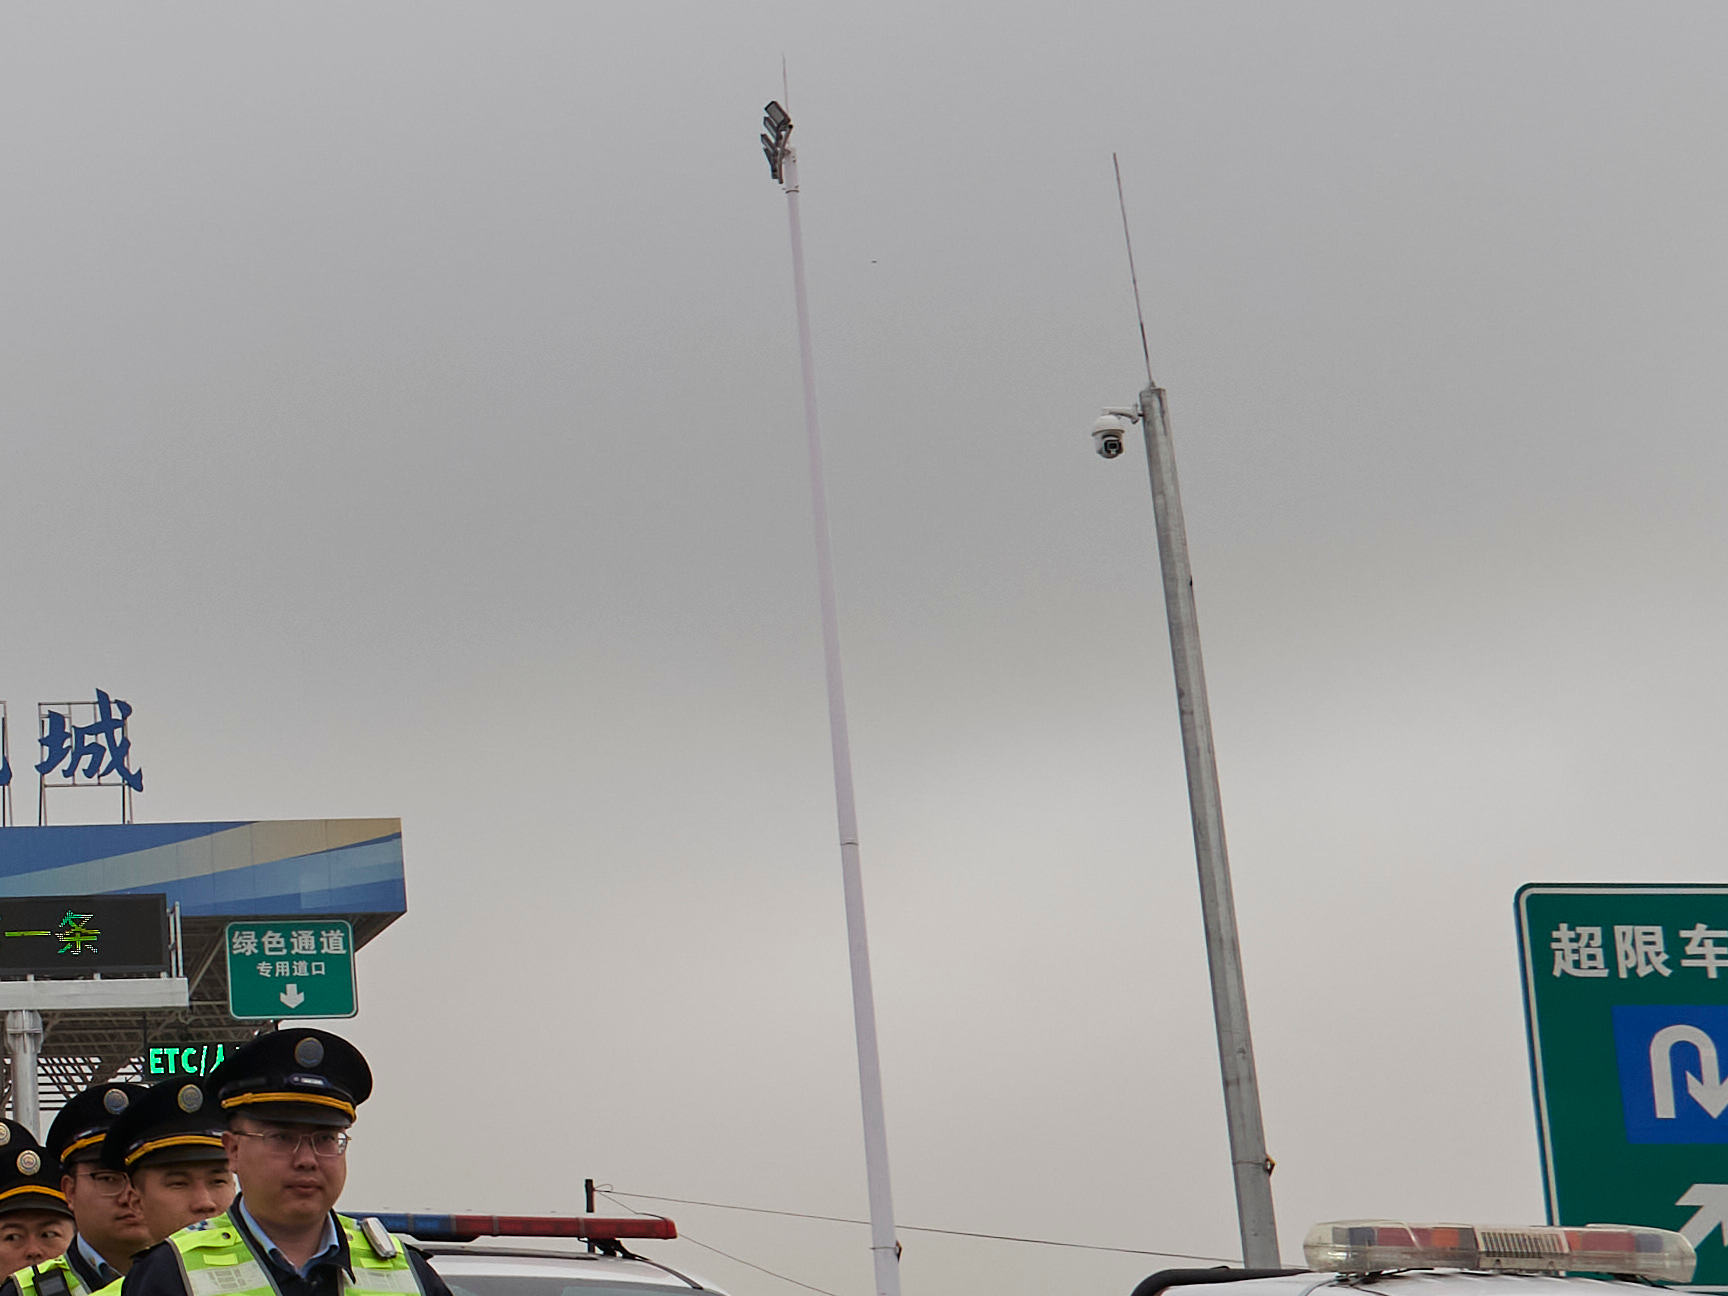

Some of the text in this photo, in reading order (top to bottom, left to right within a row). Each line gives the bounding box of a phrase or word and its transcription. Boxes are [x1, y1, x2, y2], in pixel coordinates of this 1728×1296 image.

[231, 930, 347, 957] 绿色通道
[1549, 922, 1728, 980] 超限车
[255, 961, 327, 978] 专用道口
